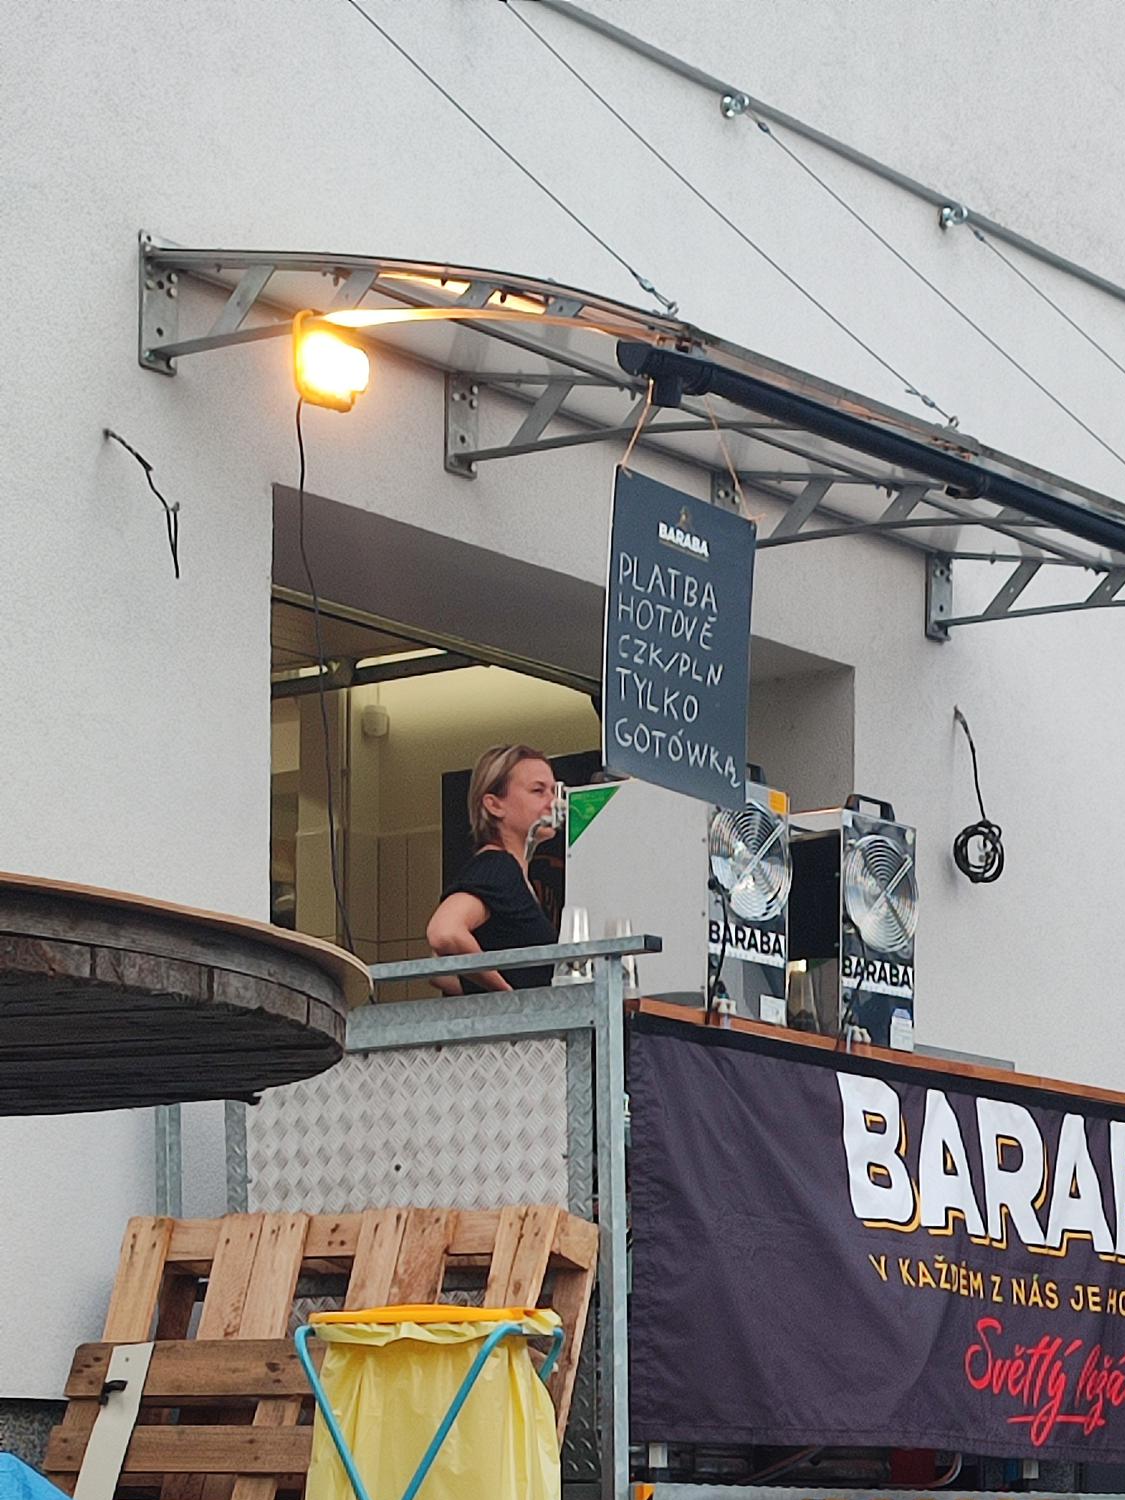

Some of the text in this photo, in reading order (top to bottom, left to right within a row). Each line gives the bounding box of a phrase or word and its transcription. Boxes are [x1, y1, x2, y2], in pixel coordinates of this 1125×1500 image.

[658, 520, 710, 558] BARABA
[618, 551, 718, 614] PLATBA
[618, 634, 724, 687] CZK/PLN
[615, 667, 699, 722] TYLKO
[614, 717, 742, 788] GOTÓWKĄ
[709, 919, 786, 958] BARABA
[842, 955, 913, 992] BARABA
[868, 1253, 888, 1282] V
[899, 1253, 985, 1300] KAŽDÉM
[991, 1275, 1004, 1303] Z
[1011, 1273, 1060, 1310] NÁS
